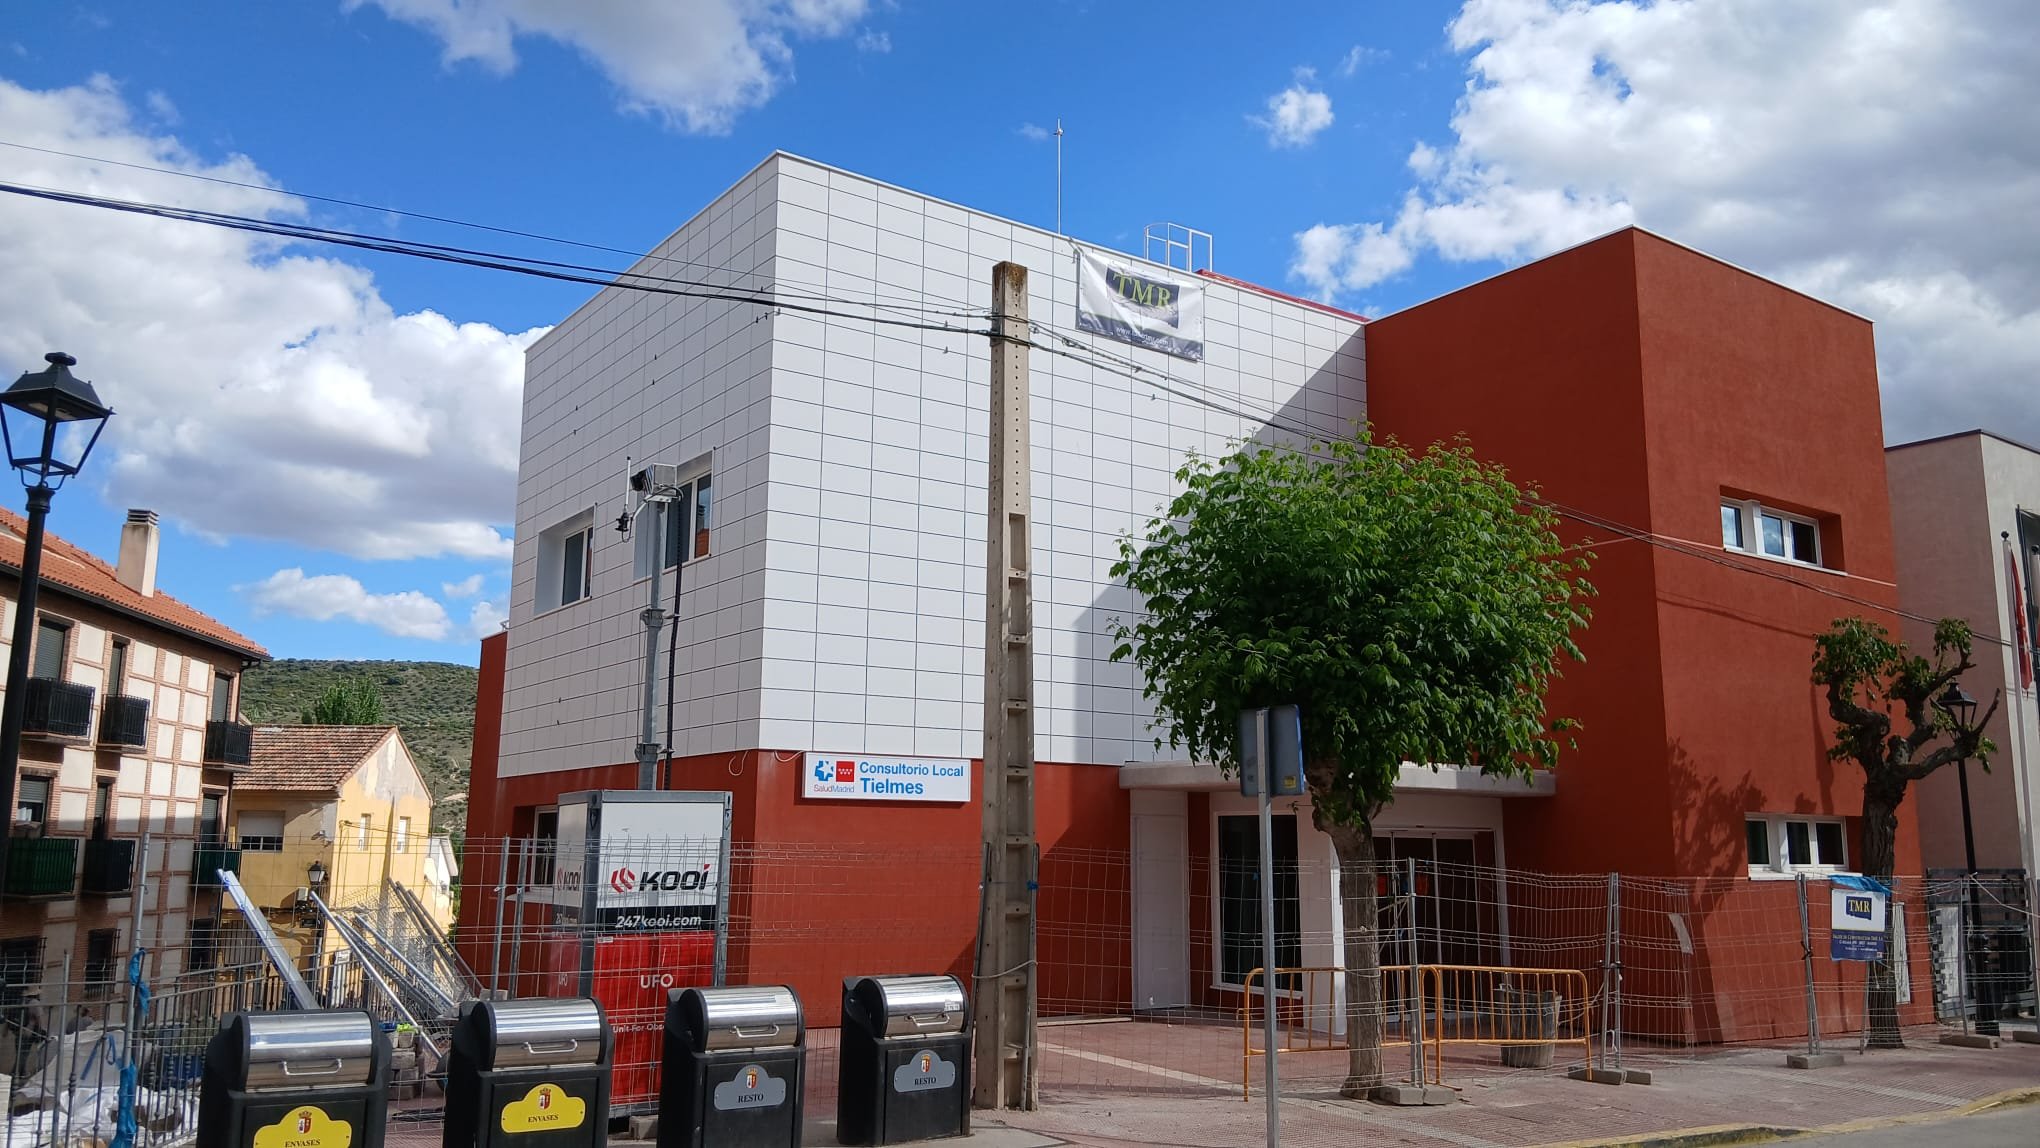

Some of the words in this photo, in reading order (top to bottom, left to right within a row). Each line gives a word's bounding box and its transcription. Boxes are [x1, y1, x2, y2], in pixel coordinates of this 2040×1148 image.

[1113, 272, 1172, 308] TMR
[859, 761, 929, 776] Consultorio
[932, 764, 964, 777] Local
[813, 784, 855, 793] SaludMadrid
[859, 777, 924, 795] Tielmes
[1848, 900, 1870, 912] TMR
[615, 913, 702, 929] 247kooi.com
[640, 973, 674, 989] UFO
[914, 1076, 937, 1086] RESTO
[738, 1093, 764, 1104] RESTO
[528, 1114, 559, 1123] ENVASES
[284, 1139, 321, 1148] ENVASES
